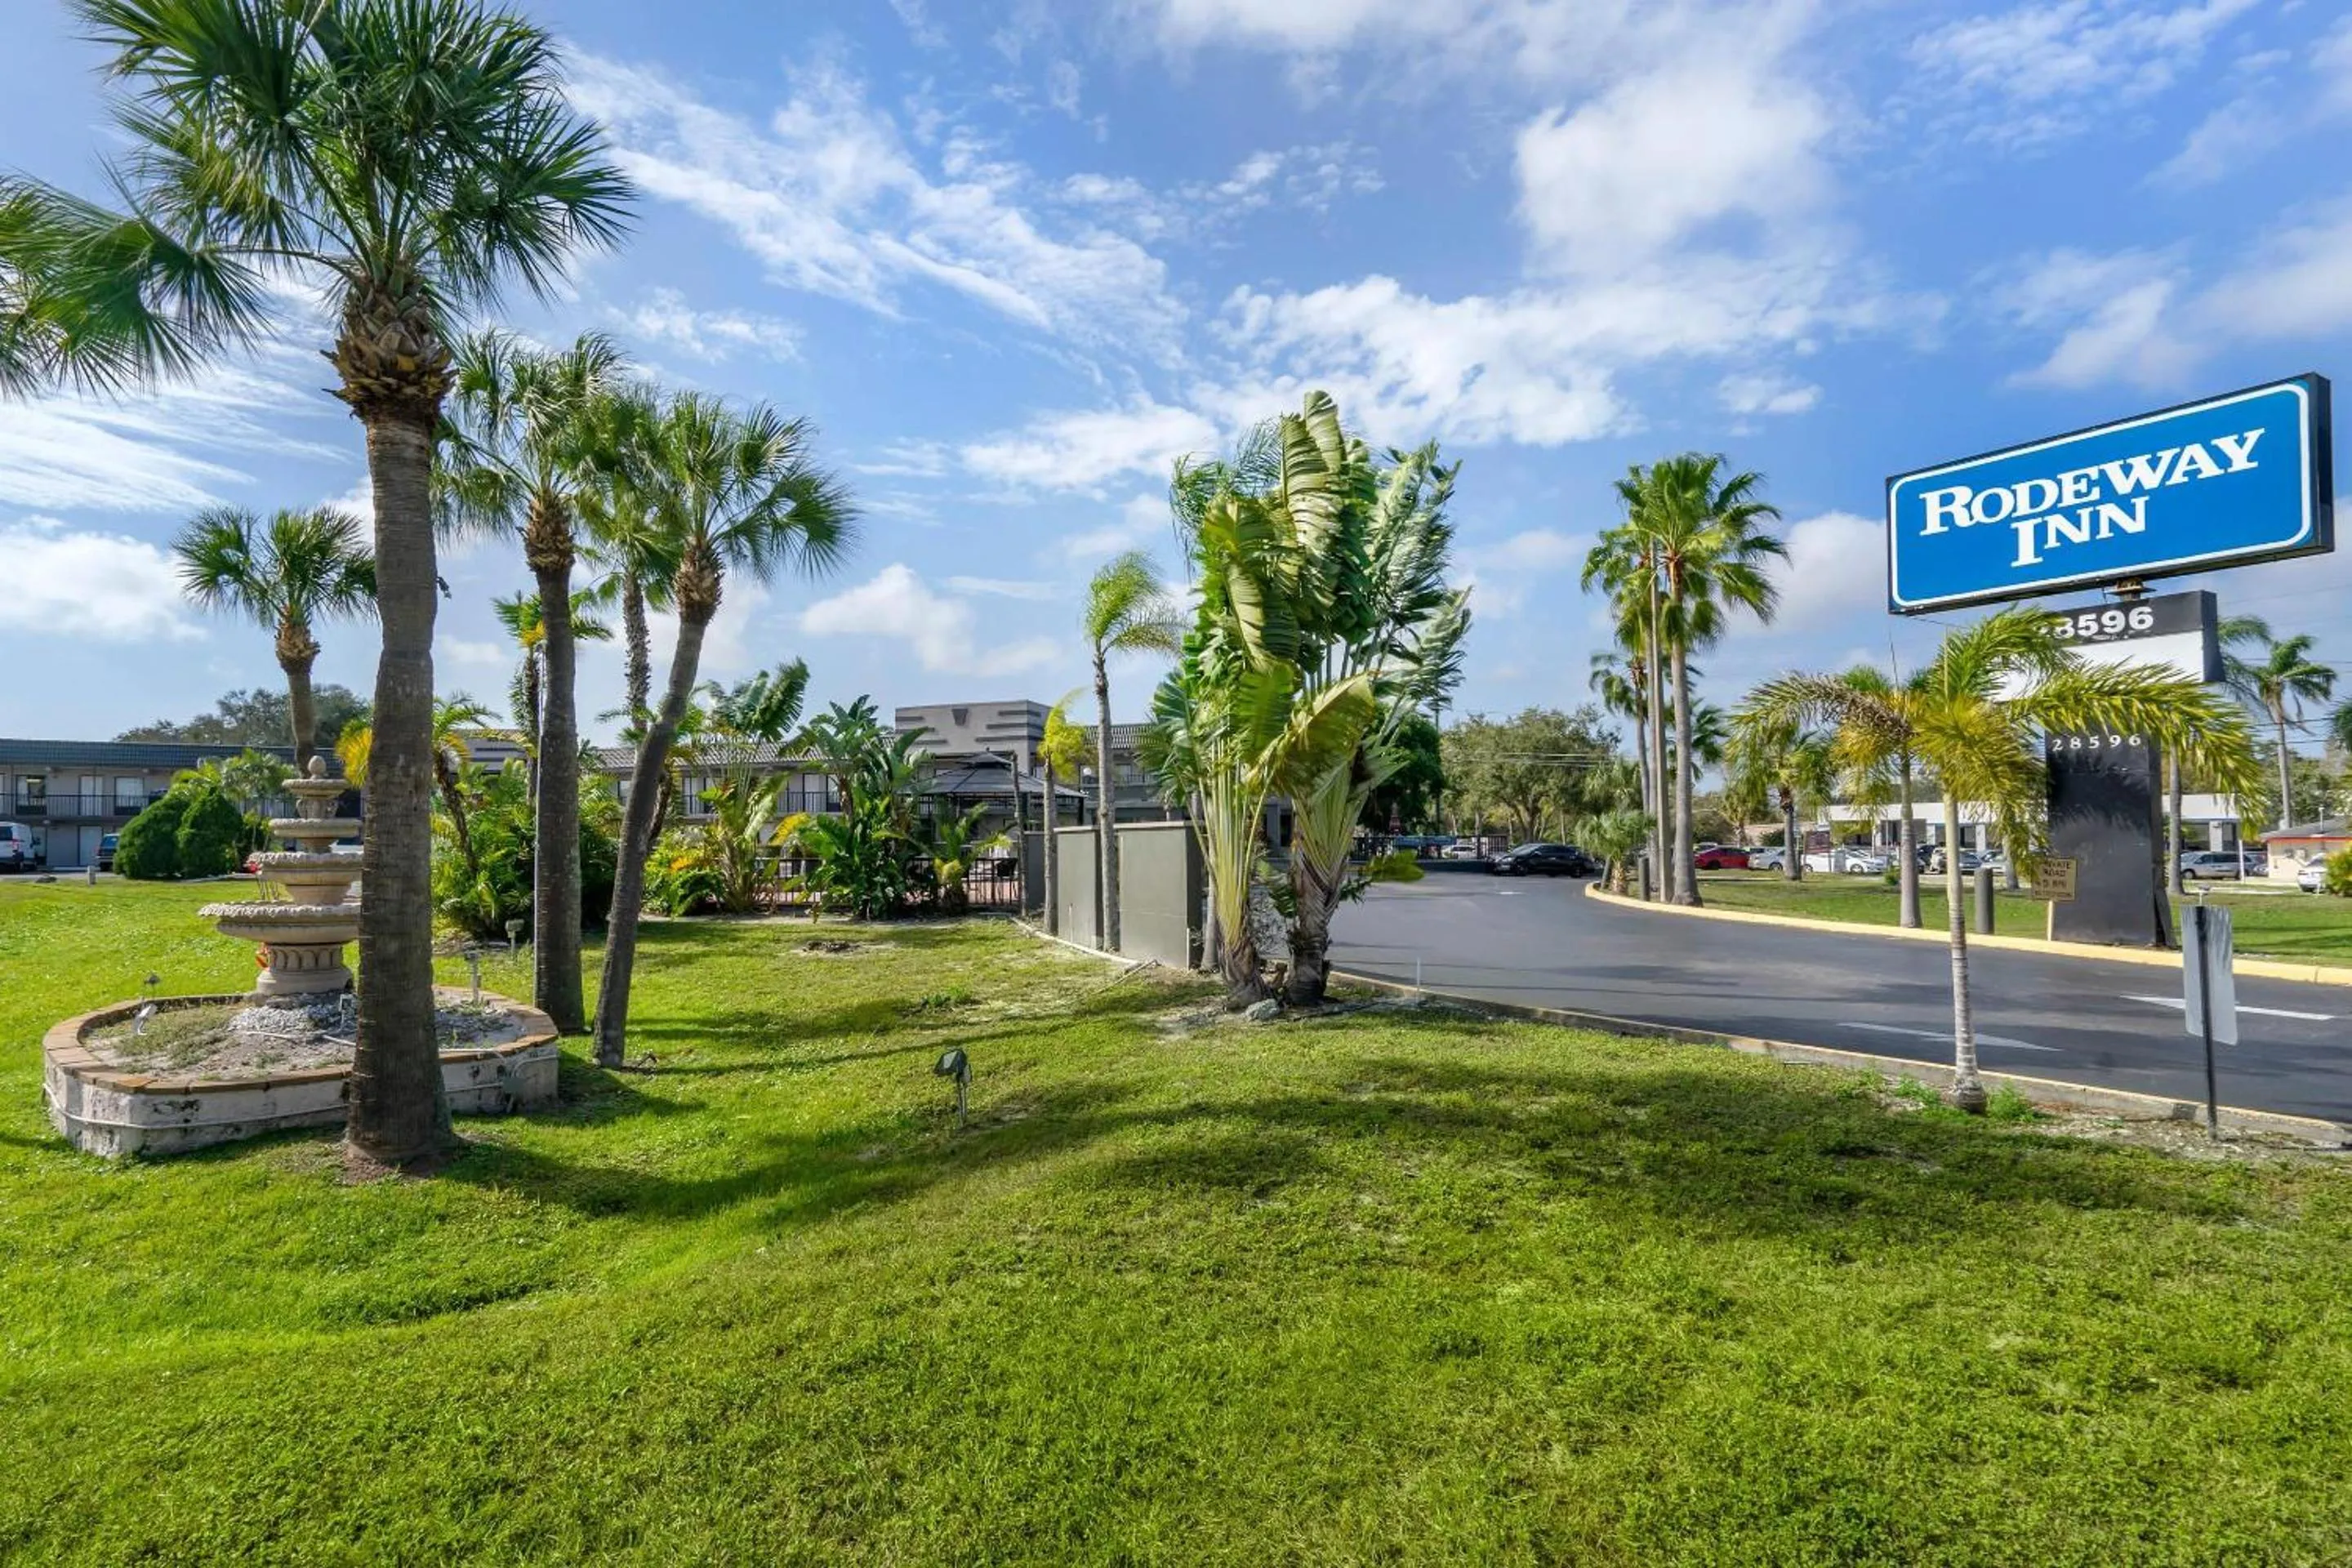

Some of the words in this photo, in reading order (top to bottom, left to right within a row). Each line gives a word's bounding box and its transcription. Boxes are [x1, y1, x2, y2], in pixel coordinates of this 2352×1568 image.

[1919, 427, 2266, 537] RODEWAY
[2010, 496, 2149, 568] INN
[2052, 734, 2141, 751] 28596
